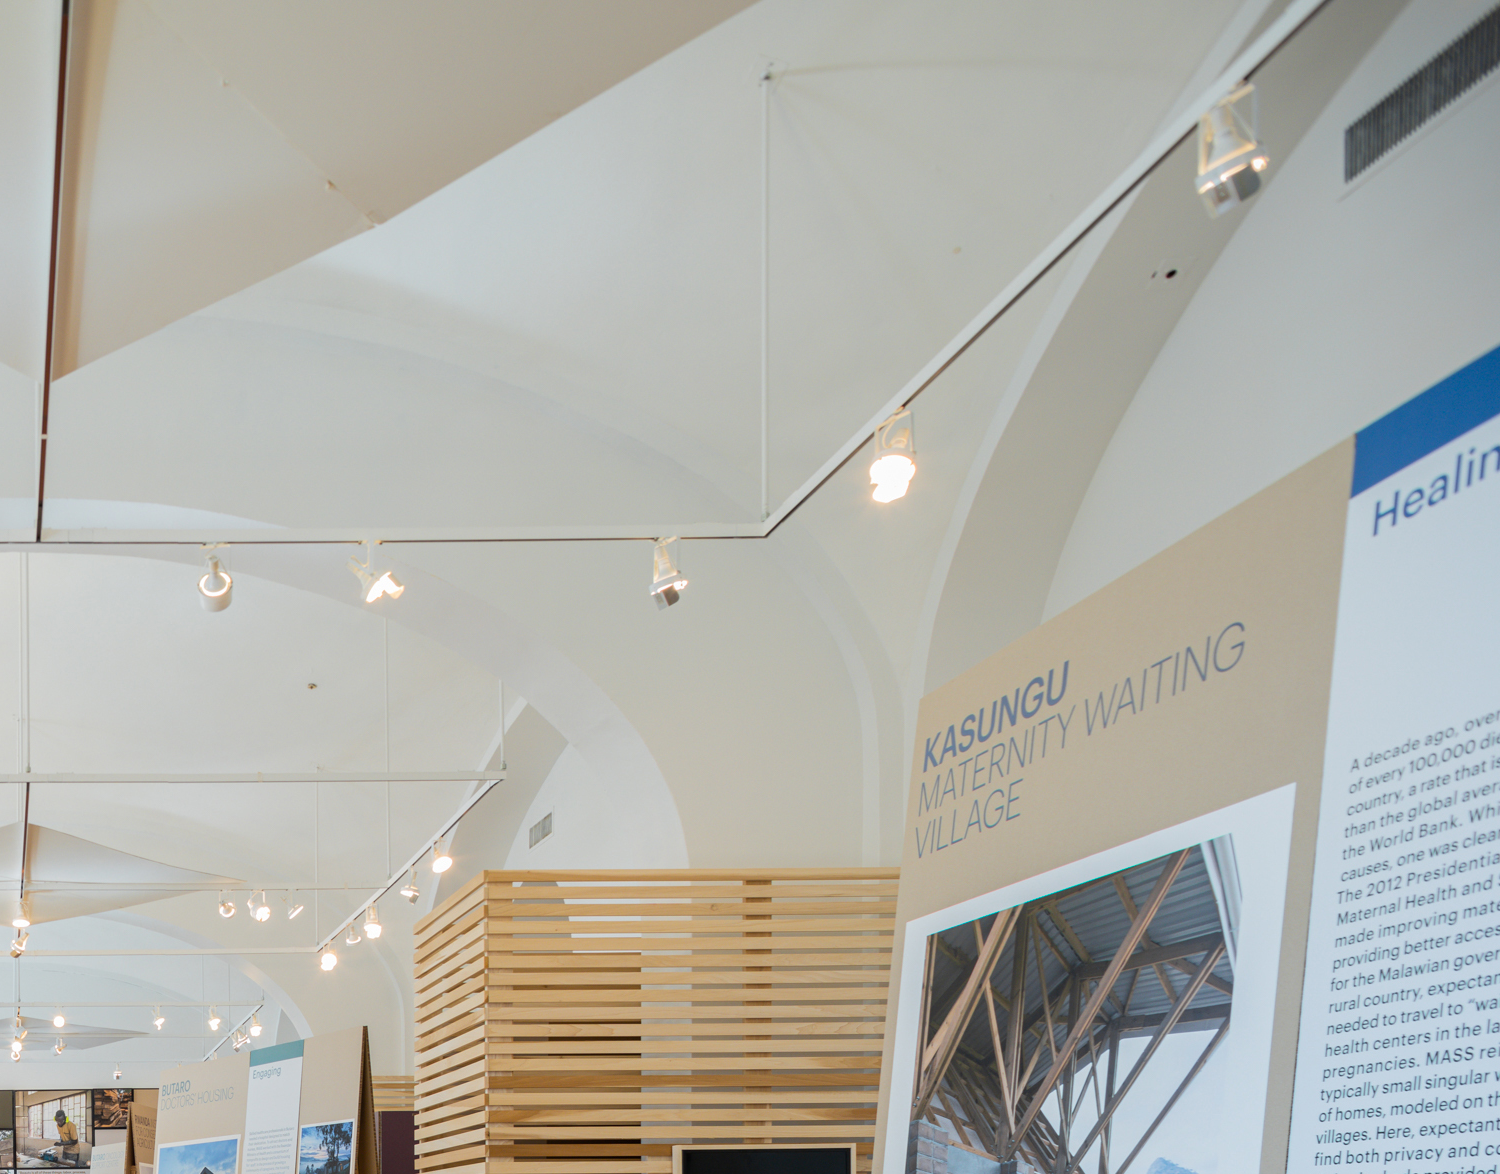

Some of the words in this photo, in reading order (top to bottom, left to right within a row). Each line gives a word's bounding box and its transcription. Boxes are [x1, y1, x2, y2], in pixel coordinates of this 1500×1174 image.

[918, 705, 1077, 817] MATERNITY
[1083, 621, 1246, 736] WAITING
[923, 660, 1069, 772] KASUNGU
[1363, 738, 1421, 768] decade
[1424, 726, 1459, 747] ago,
[915, 778, 1025, 859] VILLAGE
[1324, 1037, 1369, 1058] health
[1372, 1032, 1432, 1051] centers
[1435, 1029, 1450, 1042] in
[1454, 1022, 1482, 1039] the
[162, 1080, 191, 1096] BUTARO
[253, 1066, 281, 1080] Engaging
[1316, 1129, 1372, 1146] villages.
[1375, 1125, 1415, 1140] Here,
